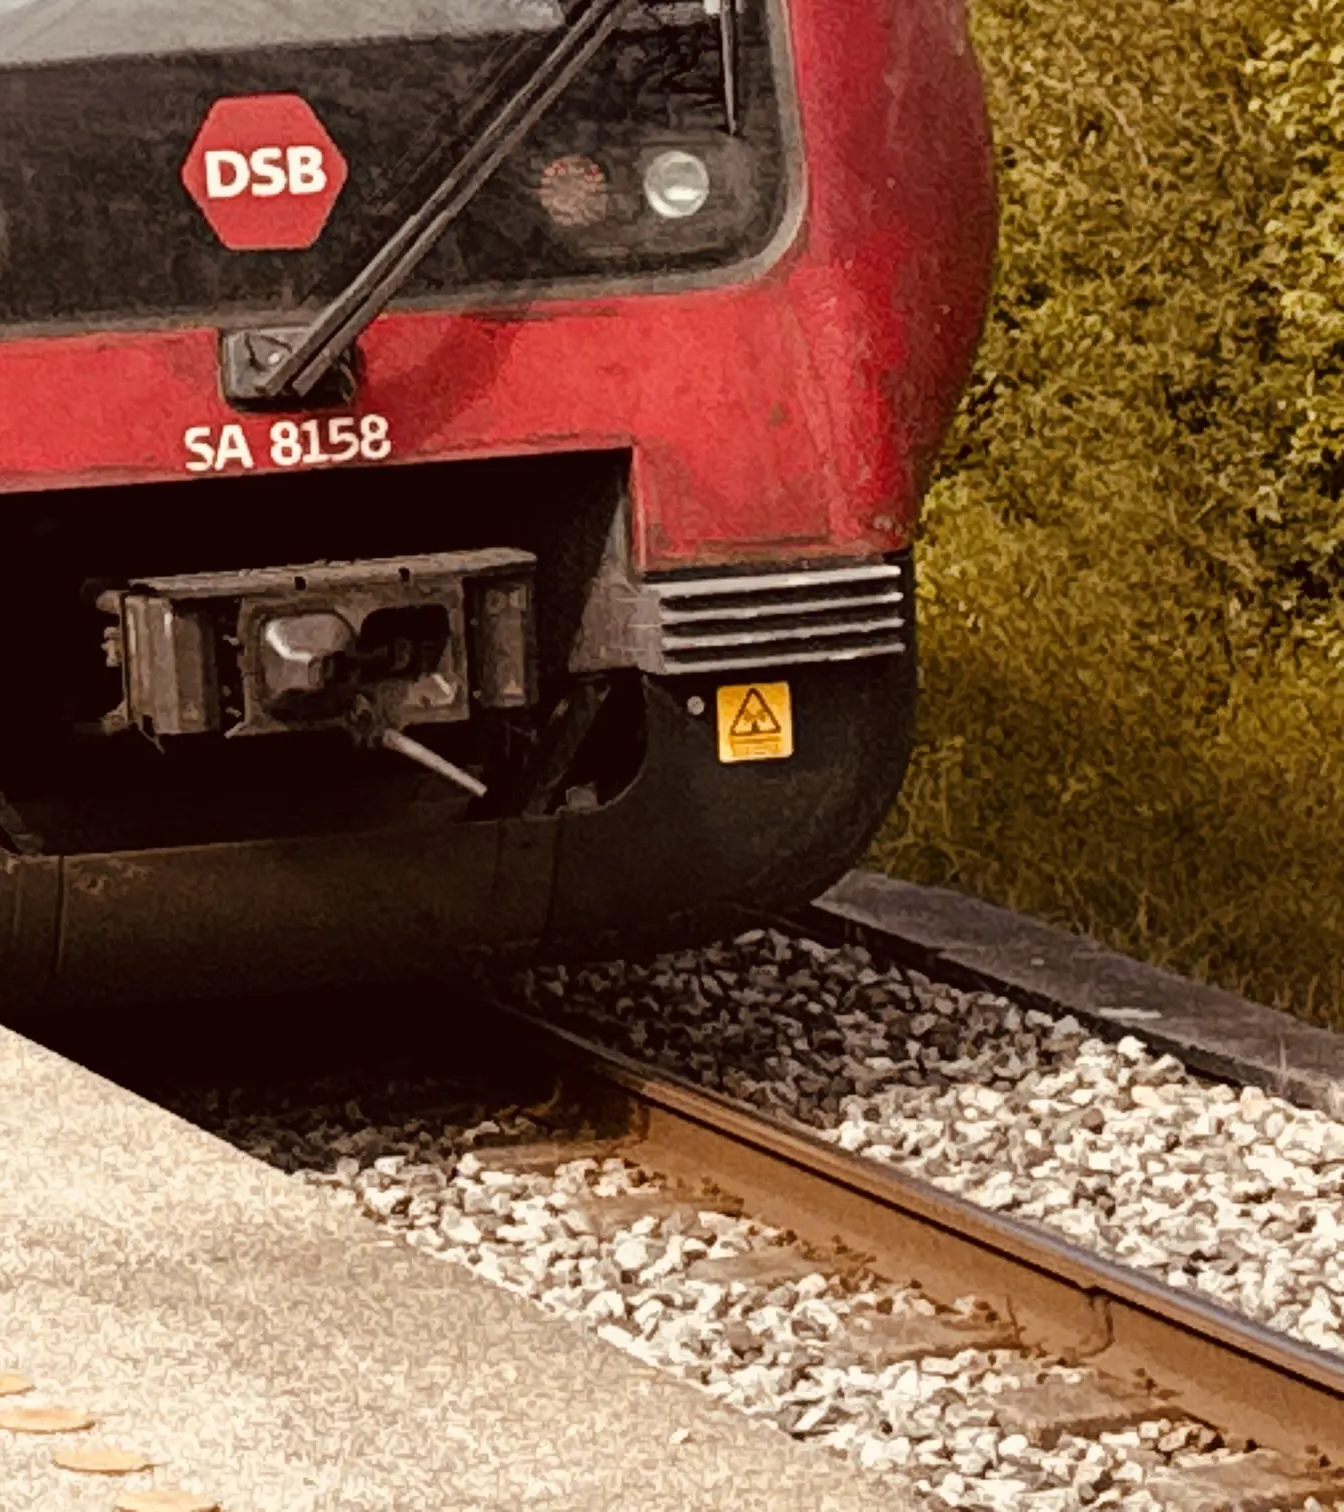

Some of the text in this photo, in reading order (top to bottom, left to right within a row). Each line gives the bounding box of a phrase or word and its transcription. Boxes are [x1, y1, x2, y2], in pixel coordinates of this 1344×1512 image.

[204, 146, 327, 198] DSB
[184, 413, 392, 472] SA 8158
